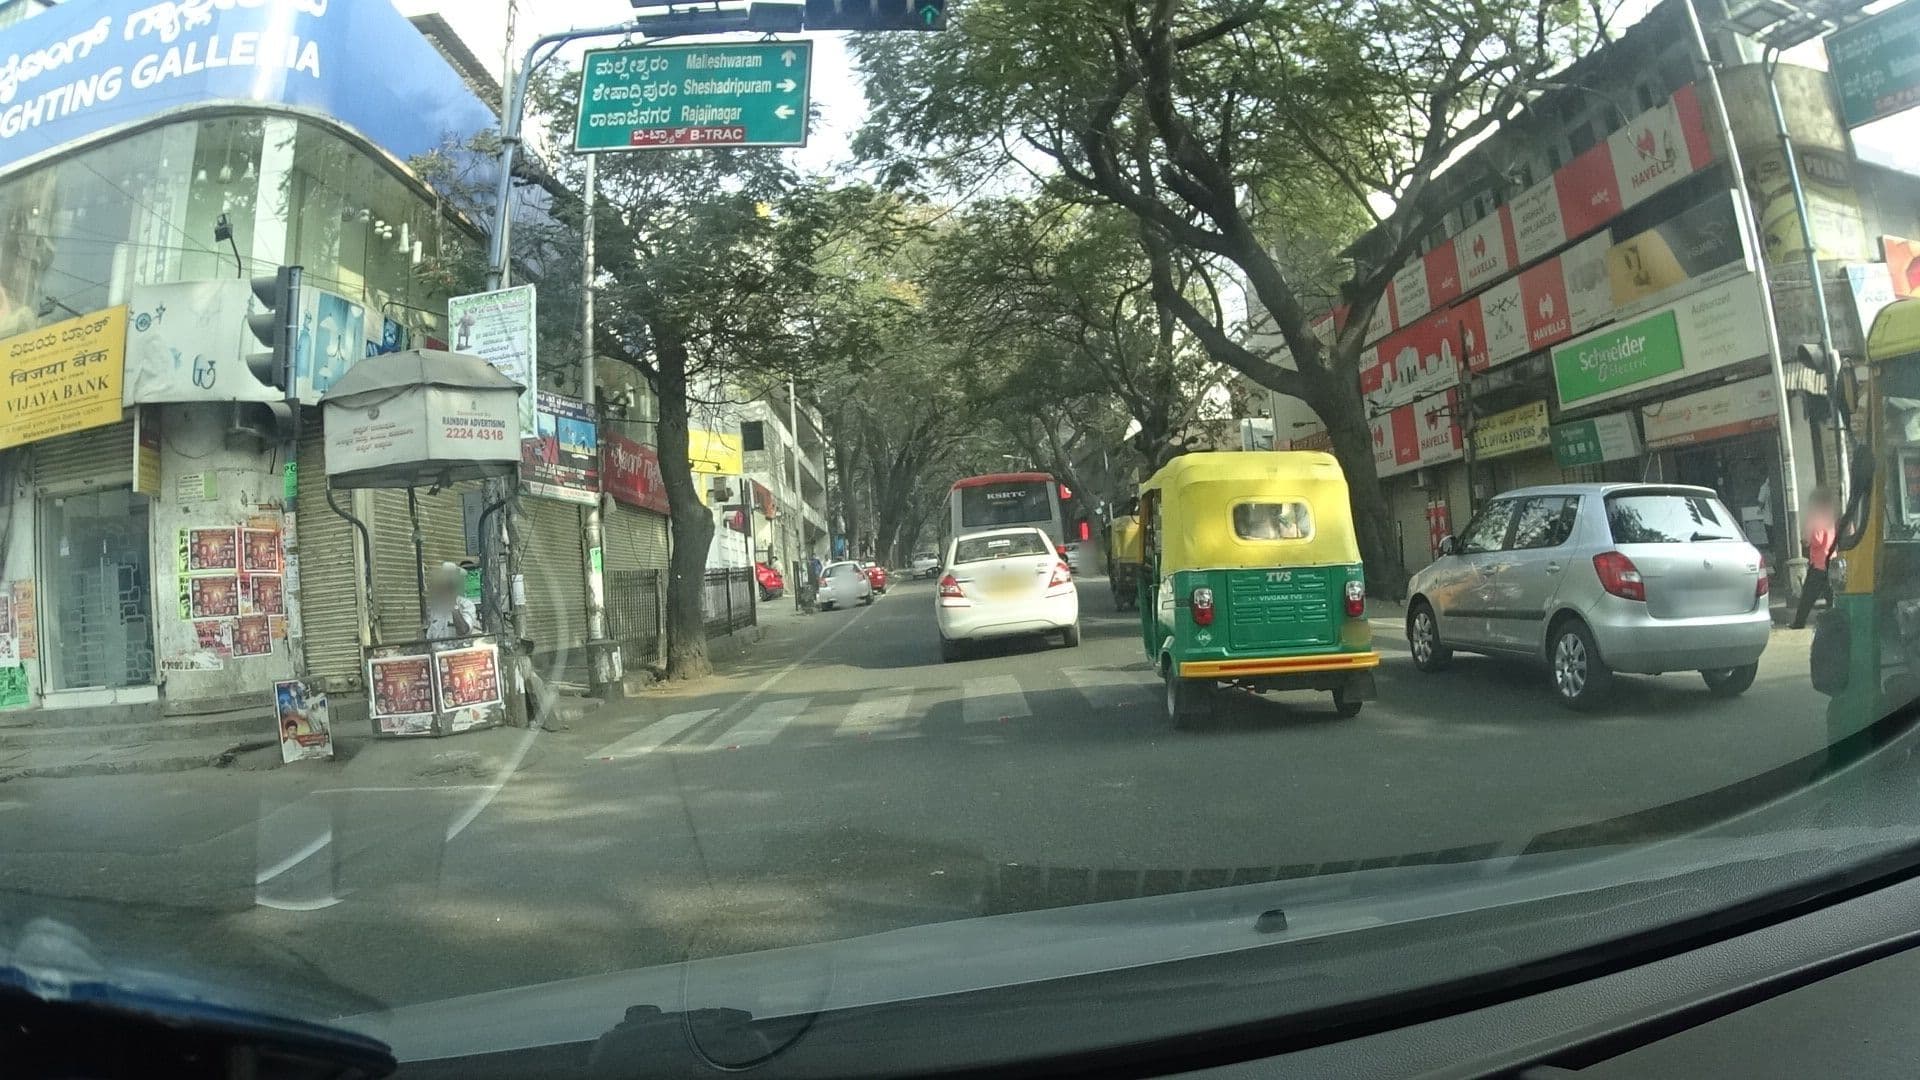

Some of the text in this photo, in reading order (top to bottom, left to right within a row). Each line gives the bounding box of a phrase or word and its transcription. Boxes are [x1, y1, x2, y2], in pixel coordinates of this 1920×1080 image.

[596, 56, 669, 80] ಮಲ್ಲೇಶ್ವರಂ
[0, 31, 321, 138] GHTING GALLEIA
[592, 78, 772, 107] ಶೇಷಾದ್ರಿಪುರಂ Sheshadripuram
[589, 105, 742, 127] ರಾಜಾಜಿನಗರ Rajajinagar
[690, 129, 743, 141] B-TRAC
[1631, 157, 1675, 189] HAVELLS
[1468, 256, 1498, 280] HAVELLS
[1533, 318, 1567, 341] HAVELLS
[1578, 336, 1646, 371] Schneider
[9, 360, 68, 387] विजया
[7, 388, 59, 414] VIJAYA
[63, 374, 110, 400] BANK
[442, 416, 506, 429] RAINBOW ADVERTISING
[446, 427, 504, 441] 2224 4318
[1420, 431, 1449, 449] HAVELLS
[987, 490, 1026, 500] KSRTC
[1266, 571, 1293, 582] TVS
